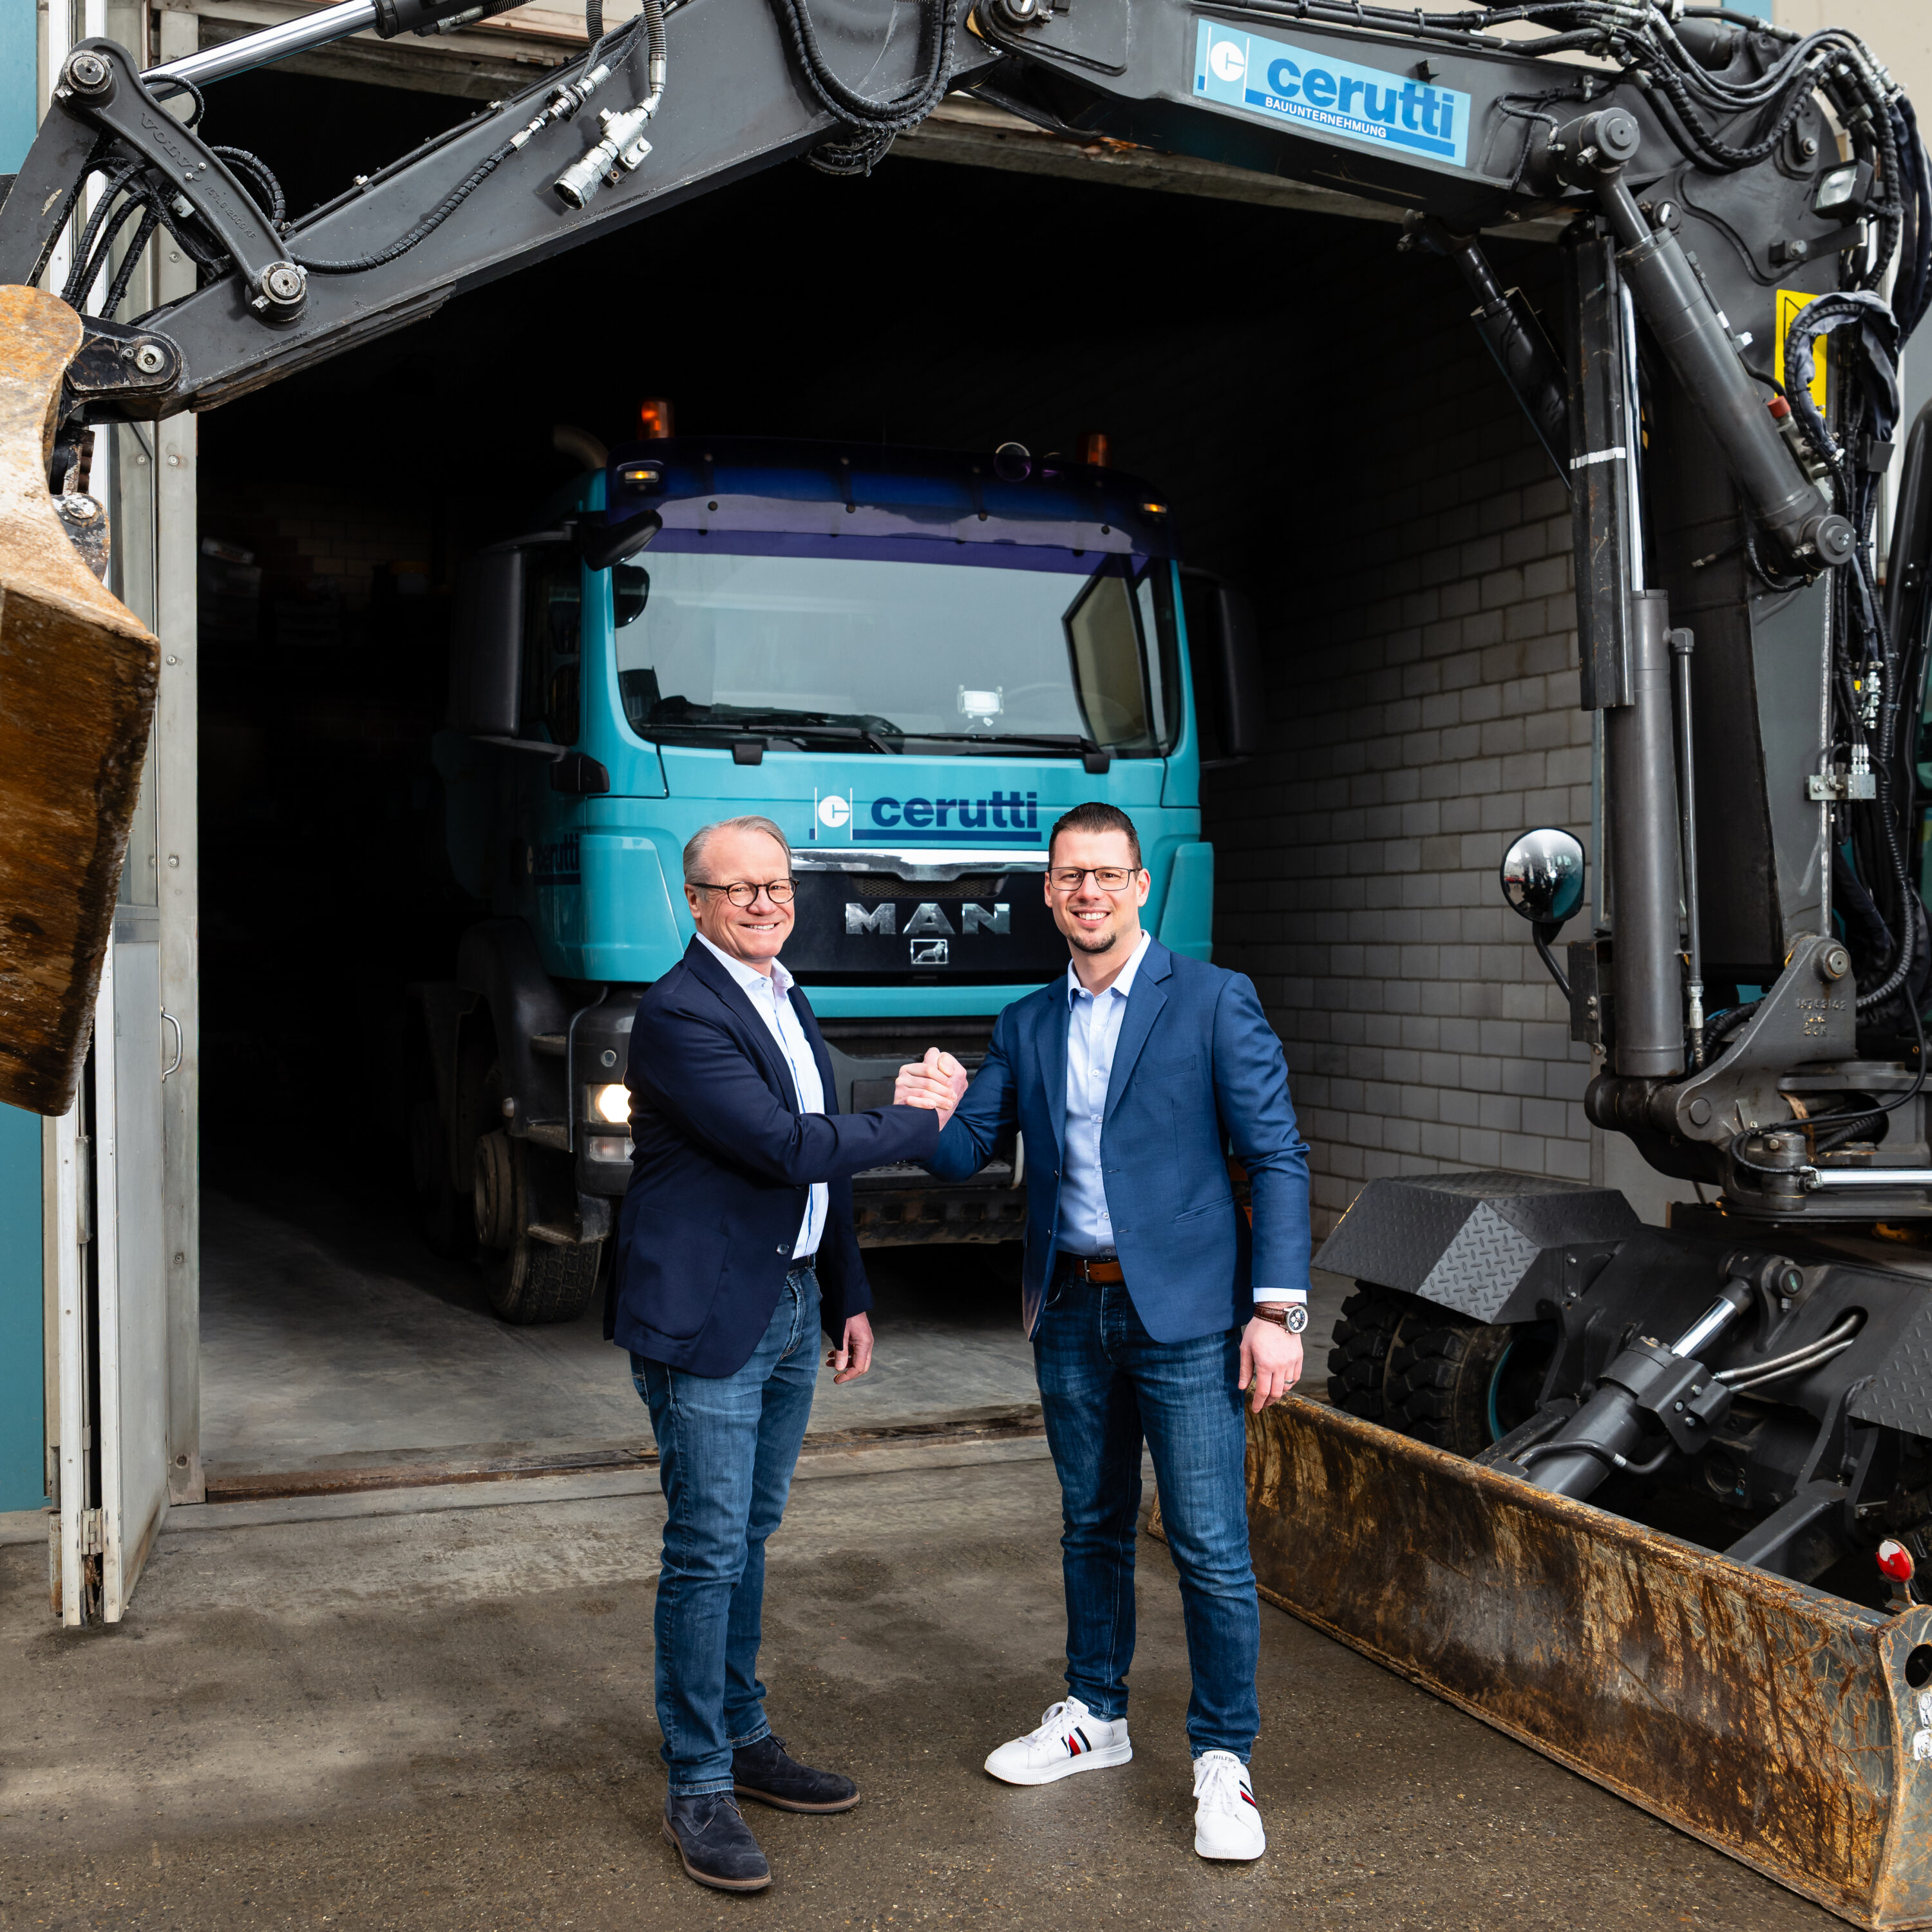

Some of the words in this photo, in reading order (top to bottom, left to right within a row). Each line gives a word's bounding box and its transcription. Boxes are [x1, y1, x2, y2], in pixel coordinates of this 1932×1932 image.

[1265, 97, 1387, 138] BAUUNTERNEHMUNG
[1267, 59, 1454, 139] cerutti
[141, 113, 202, 182] VOLVO
[871, 791, 1037, 828] cerutti
[536, 833, 580, 873] cerutti
[846, 903, 1011, 934] MAN
